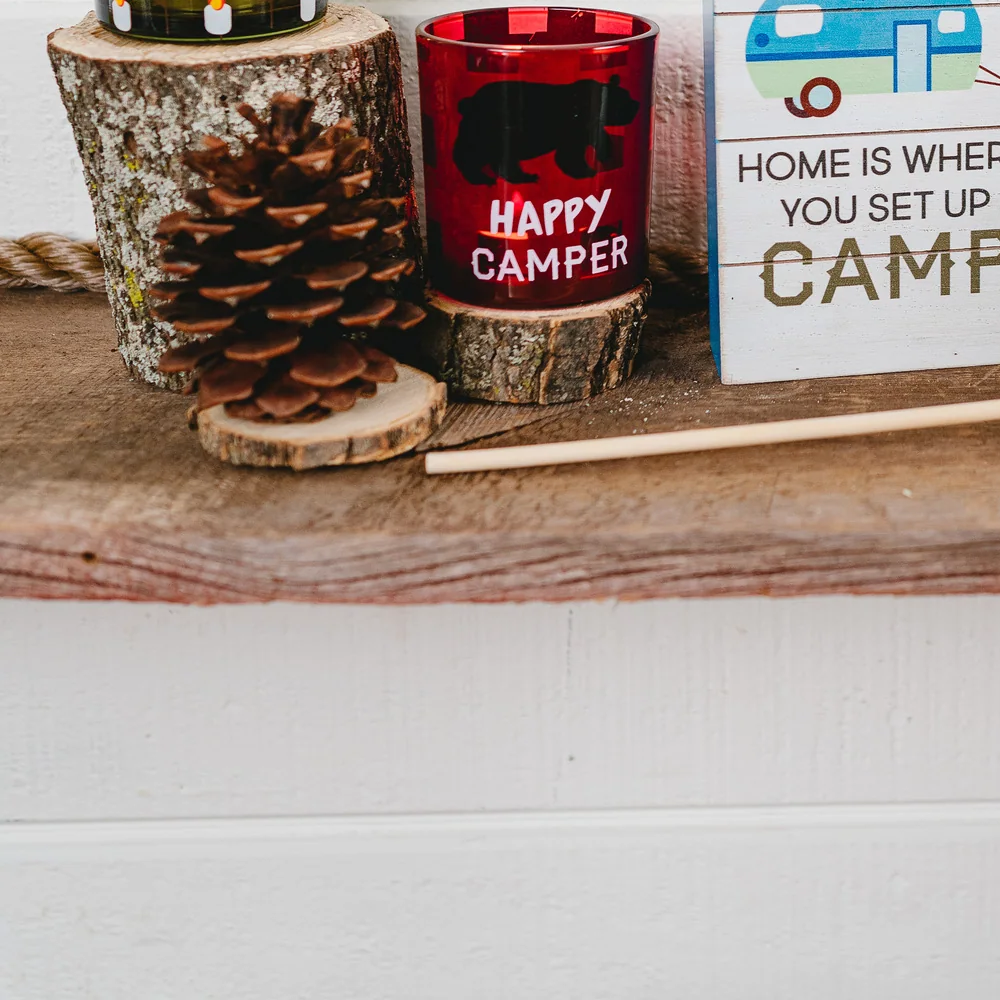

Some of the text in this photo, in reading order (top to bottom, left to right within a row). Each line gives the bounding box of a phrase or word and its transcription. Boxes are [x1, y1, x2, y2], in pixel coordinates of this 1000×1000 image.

[738, 148, 850, 183] HOME
[862, 146, 892, 176] IS
[489, 188, 612, 237] HAPPY
[780, 188, 990, 227] YOU SET UP
[471, 234, 628, 282] CAMPER
